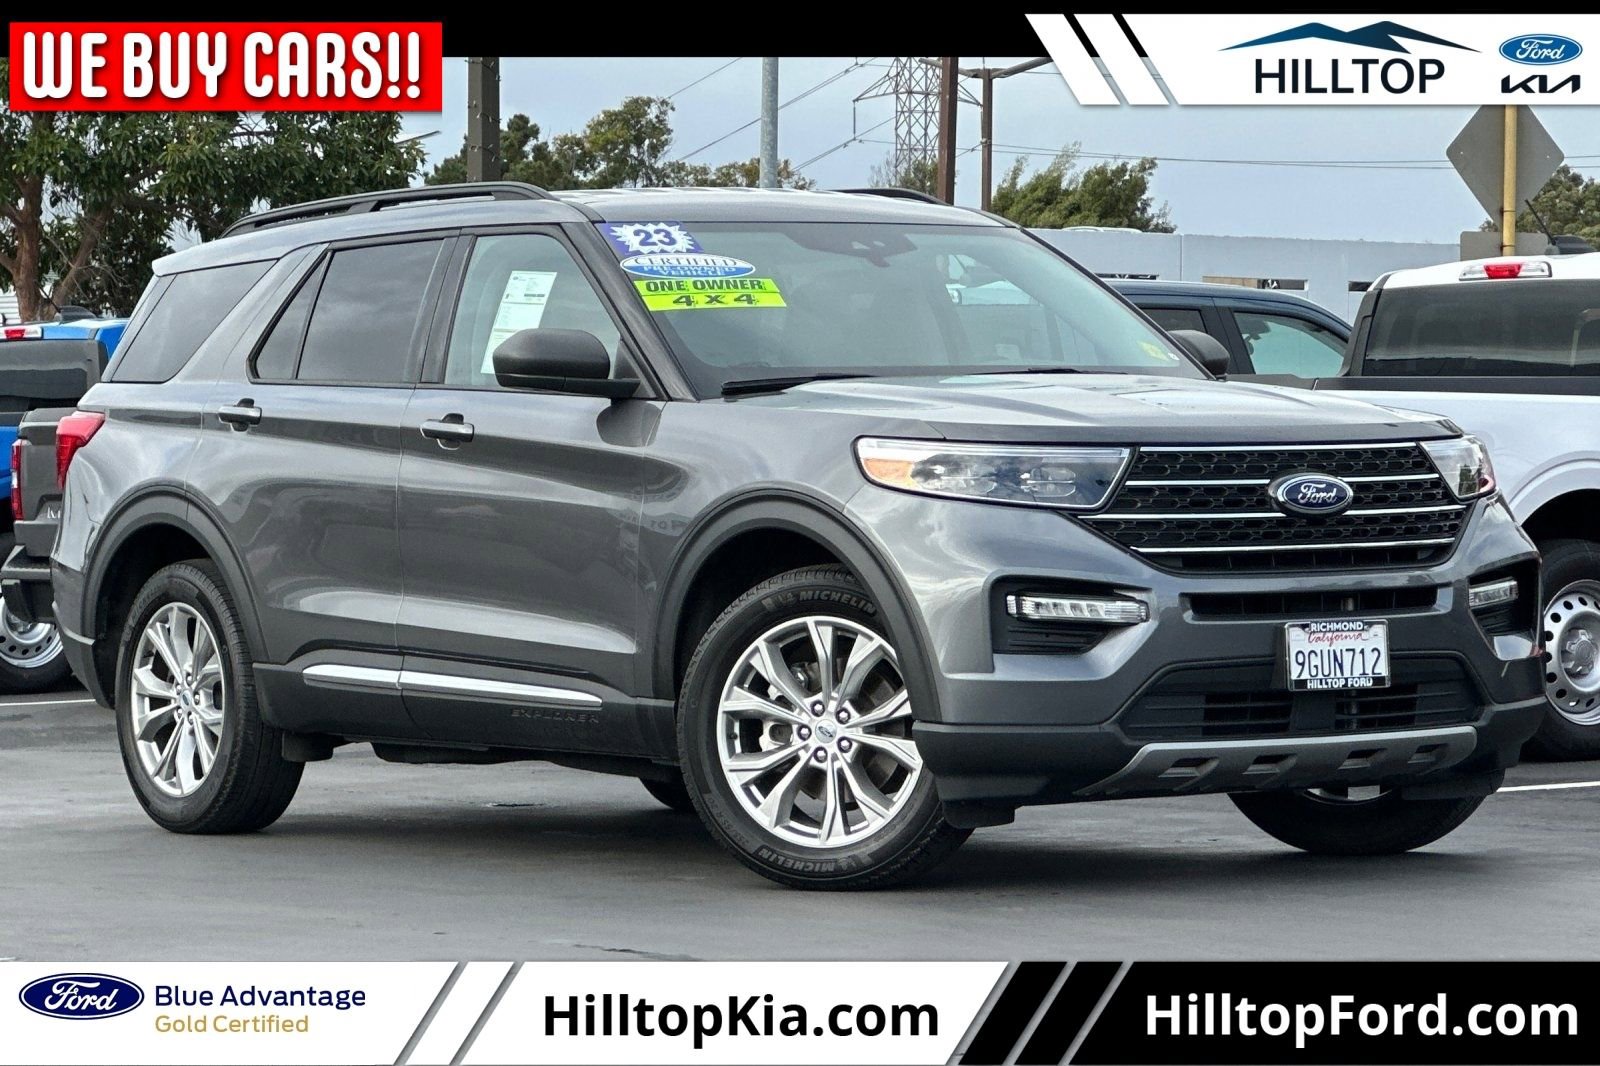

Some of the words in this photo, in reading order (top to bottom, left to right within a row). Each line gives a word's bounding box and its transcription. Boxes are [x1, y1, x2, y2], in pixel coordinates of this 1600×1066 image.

[633, 228, 677, 247] 23
[634, 257, 739, 268] CERTIFIED
[645, 280, 689, 292] ONE
[692, 279, 766, 290] OWNER
[1297, 482, 1338, 505] Ford
[800, 590, 877, 614] MICHELIN
[1310, 621, 1363, 632] RICHMOND
[1307, 631, 1370, 648] California
[1295, 647, 1383, 679] 9GUN712
[1307, 678, 1346, 690] HILLTOP
[1347, 677, 1374, 688] FORD
[758, 847, 835, 872] MICHELIN
